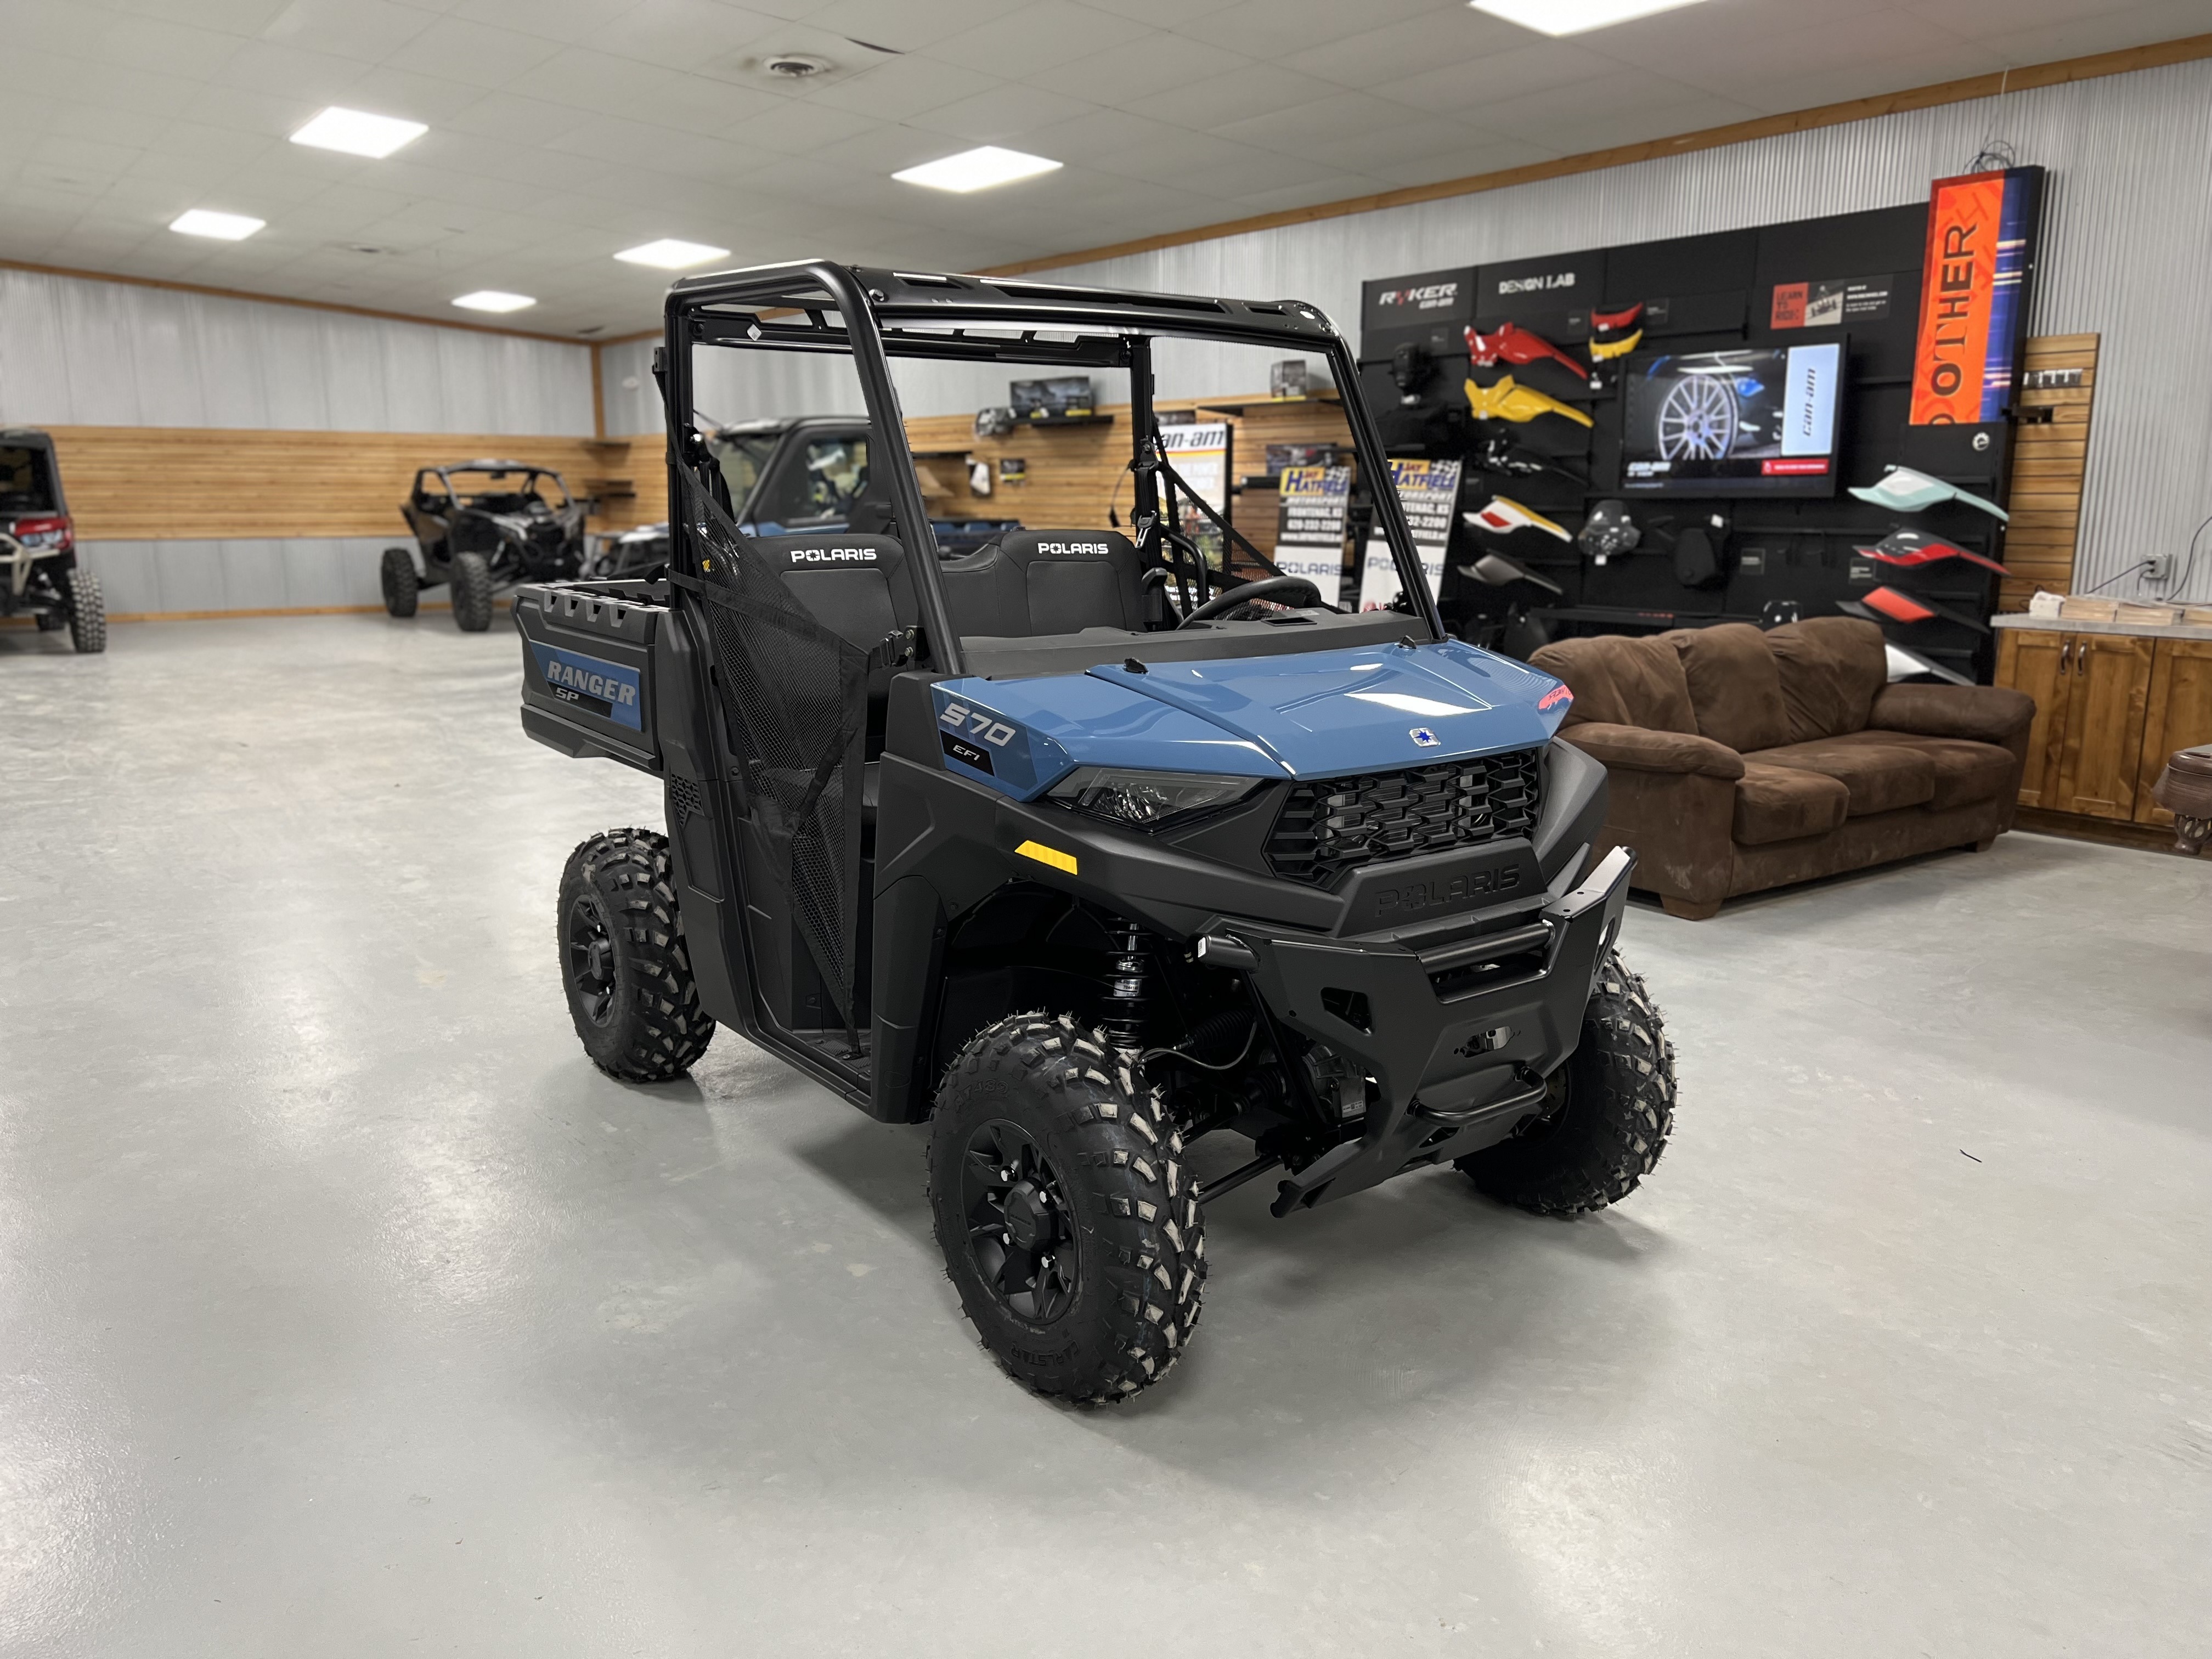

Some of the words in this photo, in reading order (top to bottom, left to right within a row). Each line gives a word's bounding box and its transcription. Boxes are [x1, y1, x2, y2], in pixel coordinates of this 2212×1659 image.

[1545, 272, 1575, 289] LAB
[1378, 283, 1458, 306] RYKER
[1161, 430, 1224, 449] an-am
[791, 549, 877, 563] POLARIS
[1038, 543, 1108, 555] POLARIS
[548, 660, 636, 706] RANGER
[555, 687, 579, 701] SP
[940, 702, 1016, 747] 570
[952, 744, 980, 761] EFI
[1374, 864, 1521, 918] POLARIS
[1011, 1340, 1079, 1366] CARLSTAR
